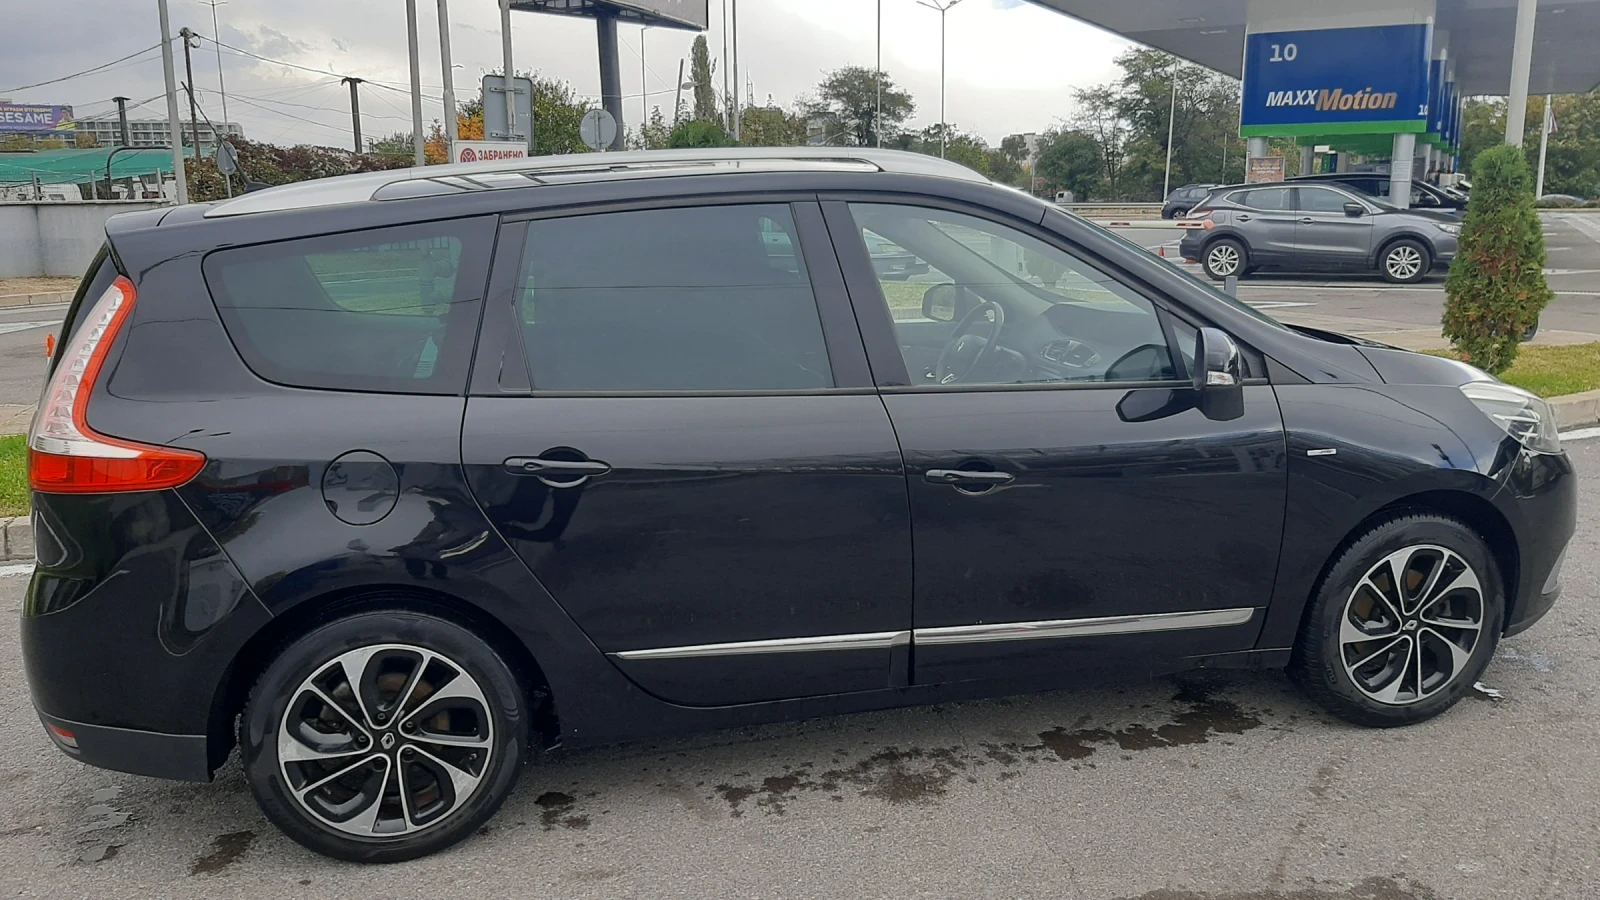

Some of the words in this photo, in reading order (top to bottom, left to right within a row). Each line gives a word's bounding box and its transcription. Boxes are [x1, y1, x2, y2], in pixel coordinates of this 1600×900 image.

[1269, 43, 1298, 62] 10
[0, 112, 54, 124] SESAME
[478, 149, 524, 161] ЗАБРАНЕНО
